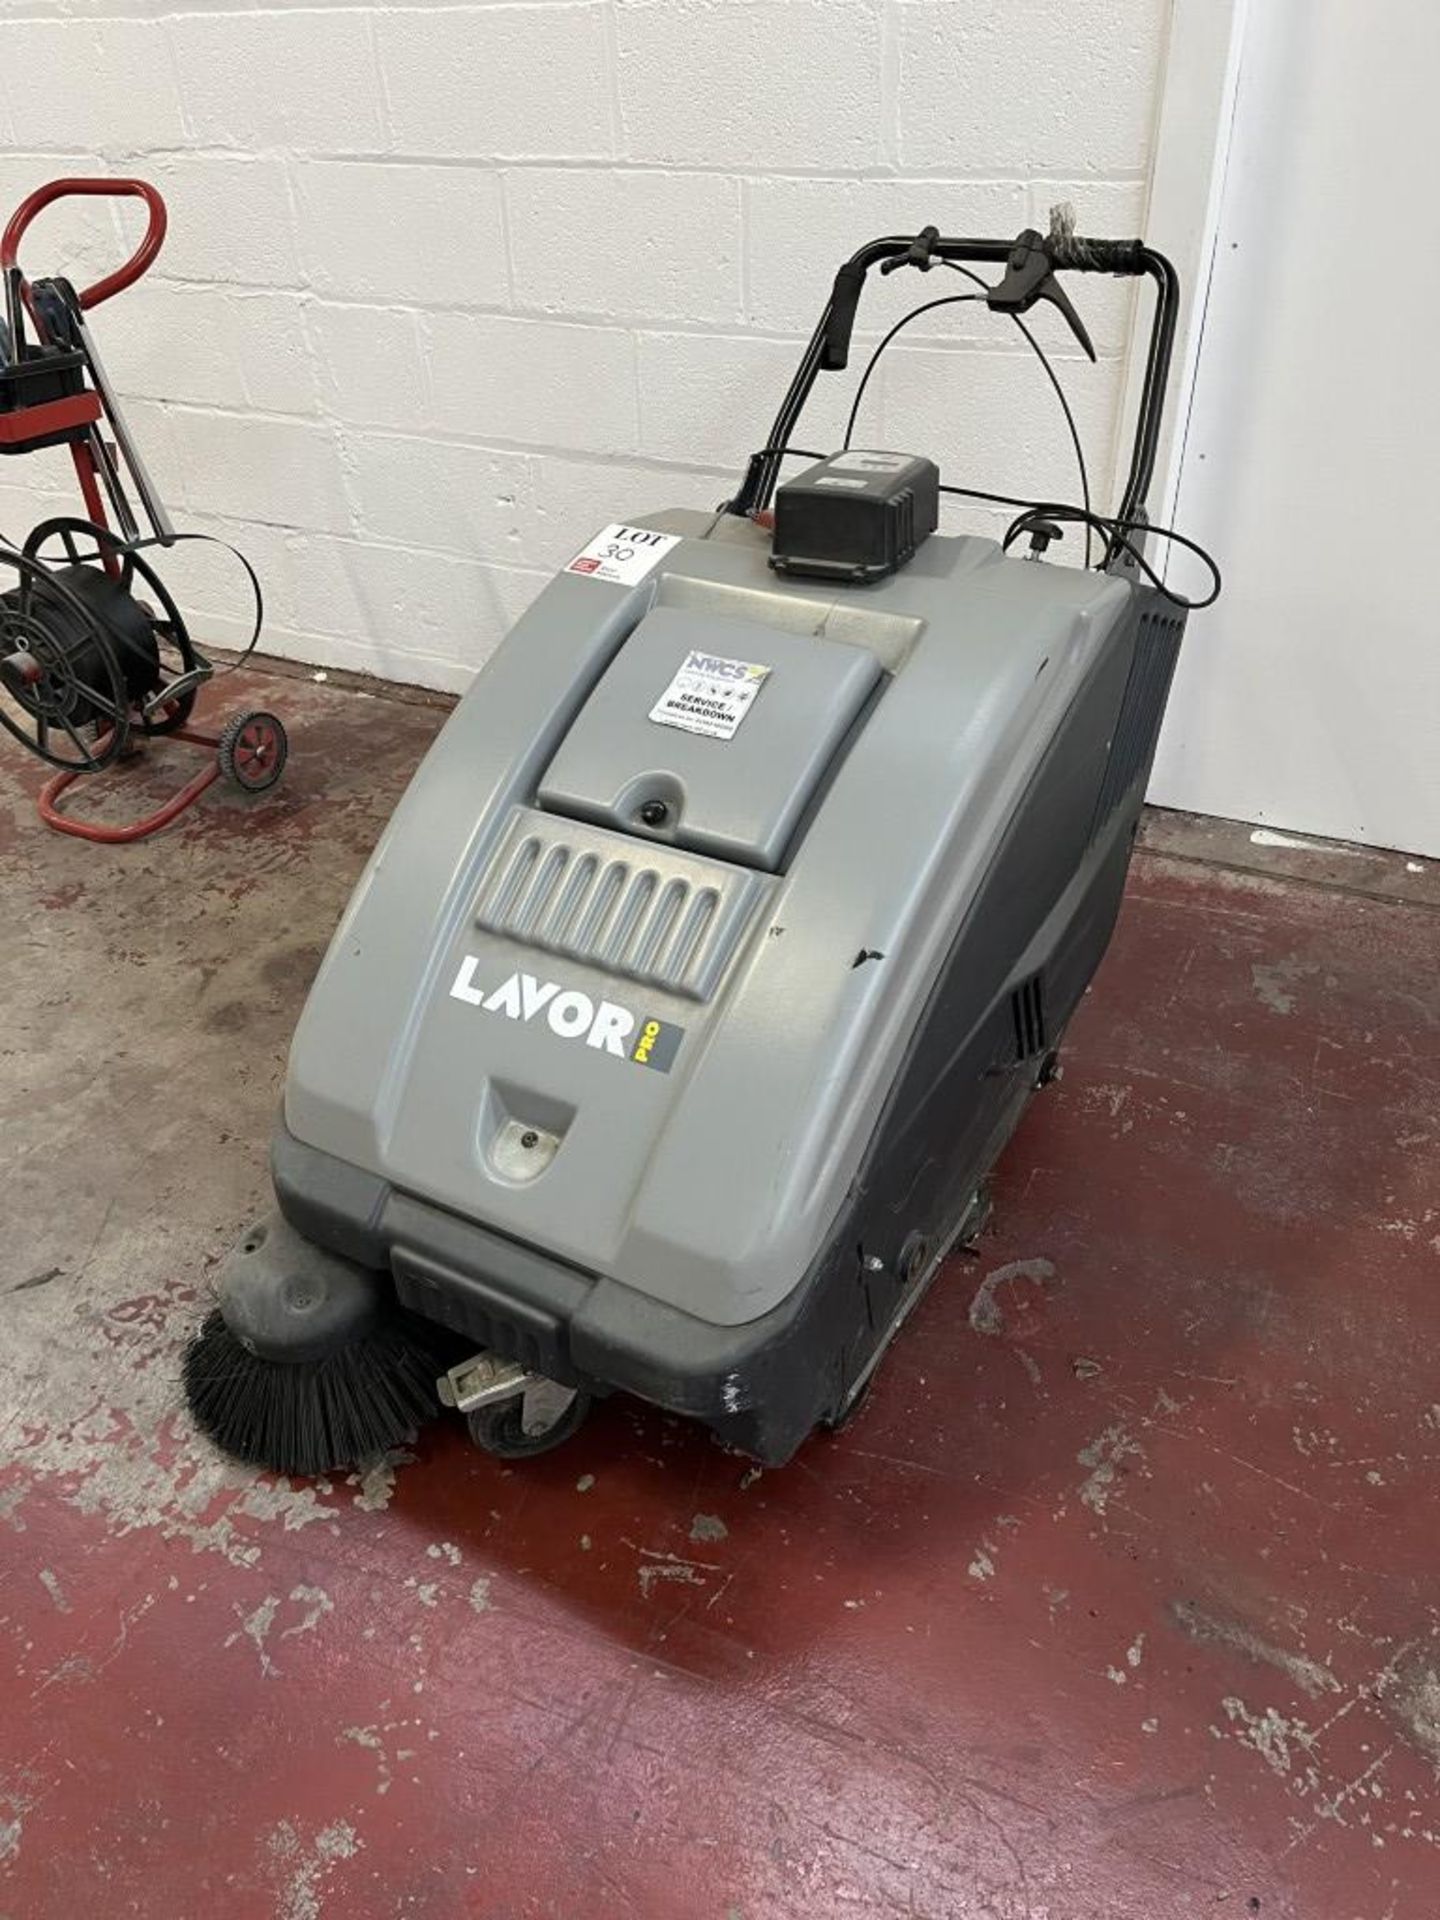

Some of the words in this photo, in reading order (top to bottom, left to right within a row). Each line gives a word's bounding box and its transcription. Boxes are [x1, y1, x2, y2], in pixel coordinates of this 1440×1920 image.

[614, 528, 668, 546] LOT
[598, 544, 634, 561] 30
[666, 700, 735, 722] BREAKDOWN
[680, 693, 726, 710] SERVICE
[450, 955, 635, 1059] LAVOR
[635, 1021, 660, 1063] PRO
